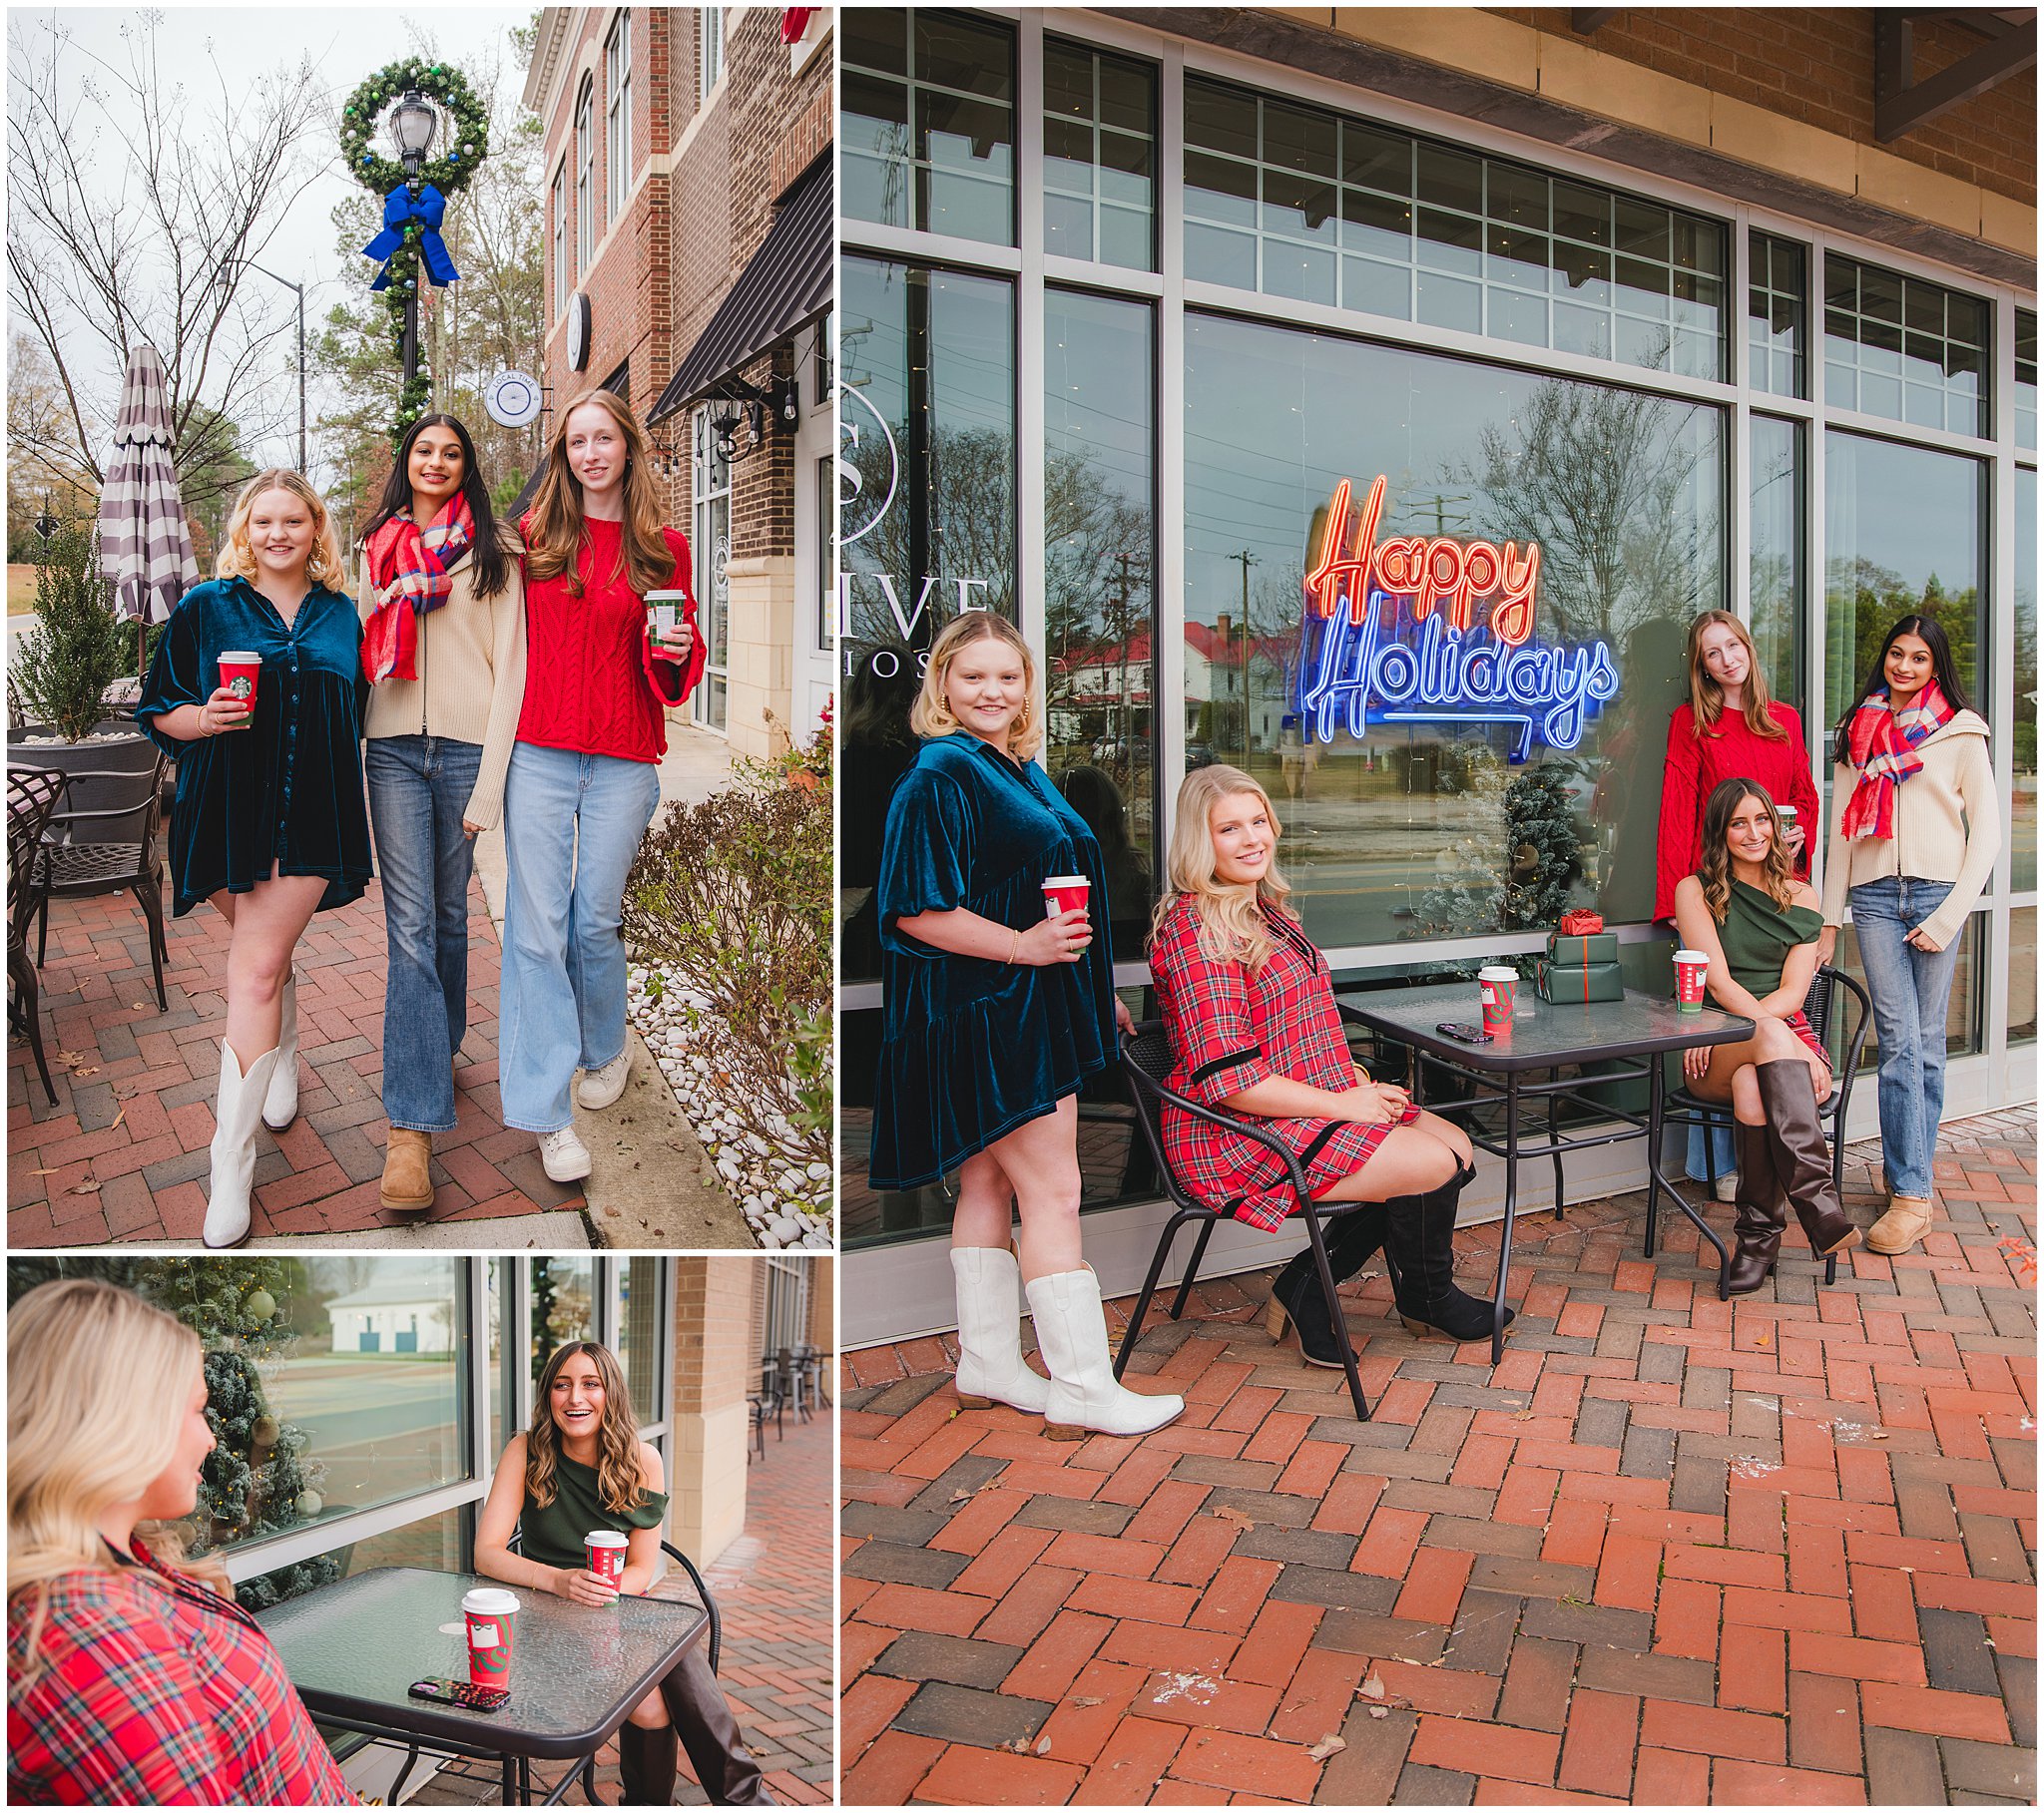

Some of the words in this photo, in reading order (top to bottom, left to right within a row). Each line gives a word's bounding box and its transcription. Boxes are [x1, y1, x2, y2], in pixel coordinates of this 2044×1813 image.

[493, 373, 516, 388] LOCAL
[518, 374, 535, 389] TIME
[1305, 474, 1541, 647] Happy
[1303, 590, 1620, 750] Holidays
